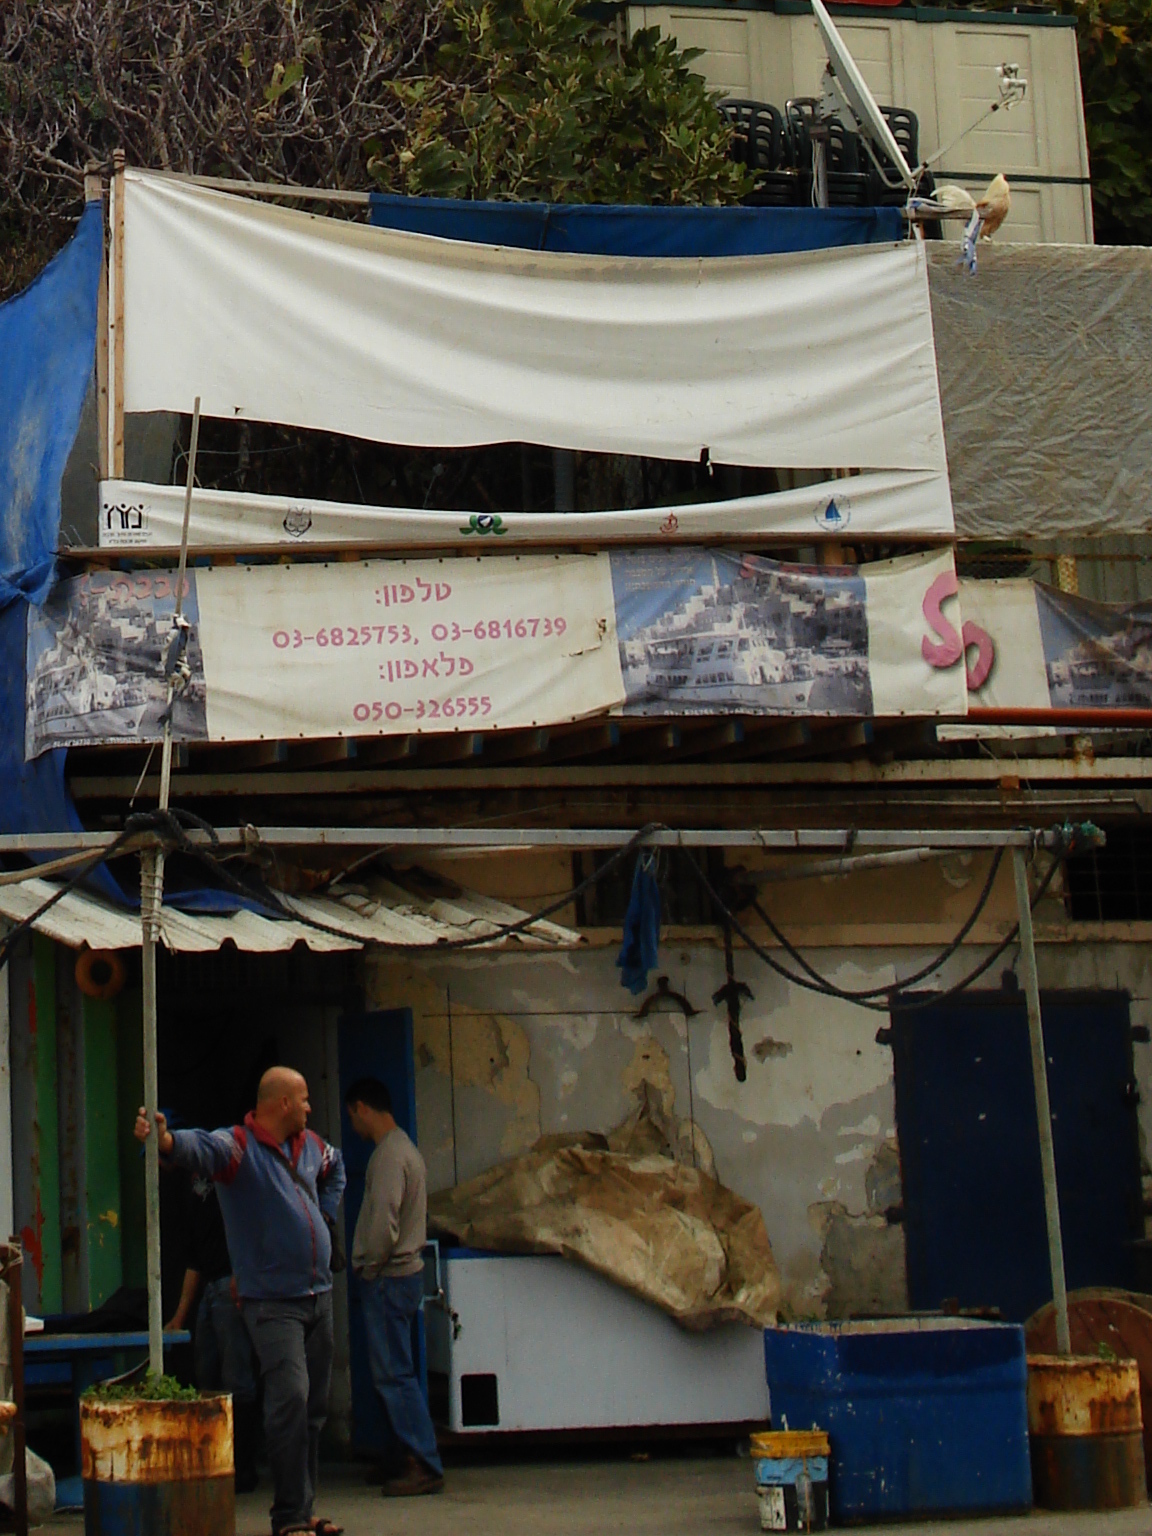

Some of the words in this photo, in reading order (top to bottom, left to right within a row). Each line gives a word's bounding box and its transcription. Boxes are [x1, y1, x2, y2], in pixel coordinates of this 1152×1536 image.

[375, 577, 452, 607] טלפון:
[272, 624, 420, 649] 03-6825753,
[431, 616, 567, 642] 03-6816739
[379, 651, 474, 682] פלאפון:
[353, 696, 492, 722] 050-326555
